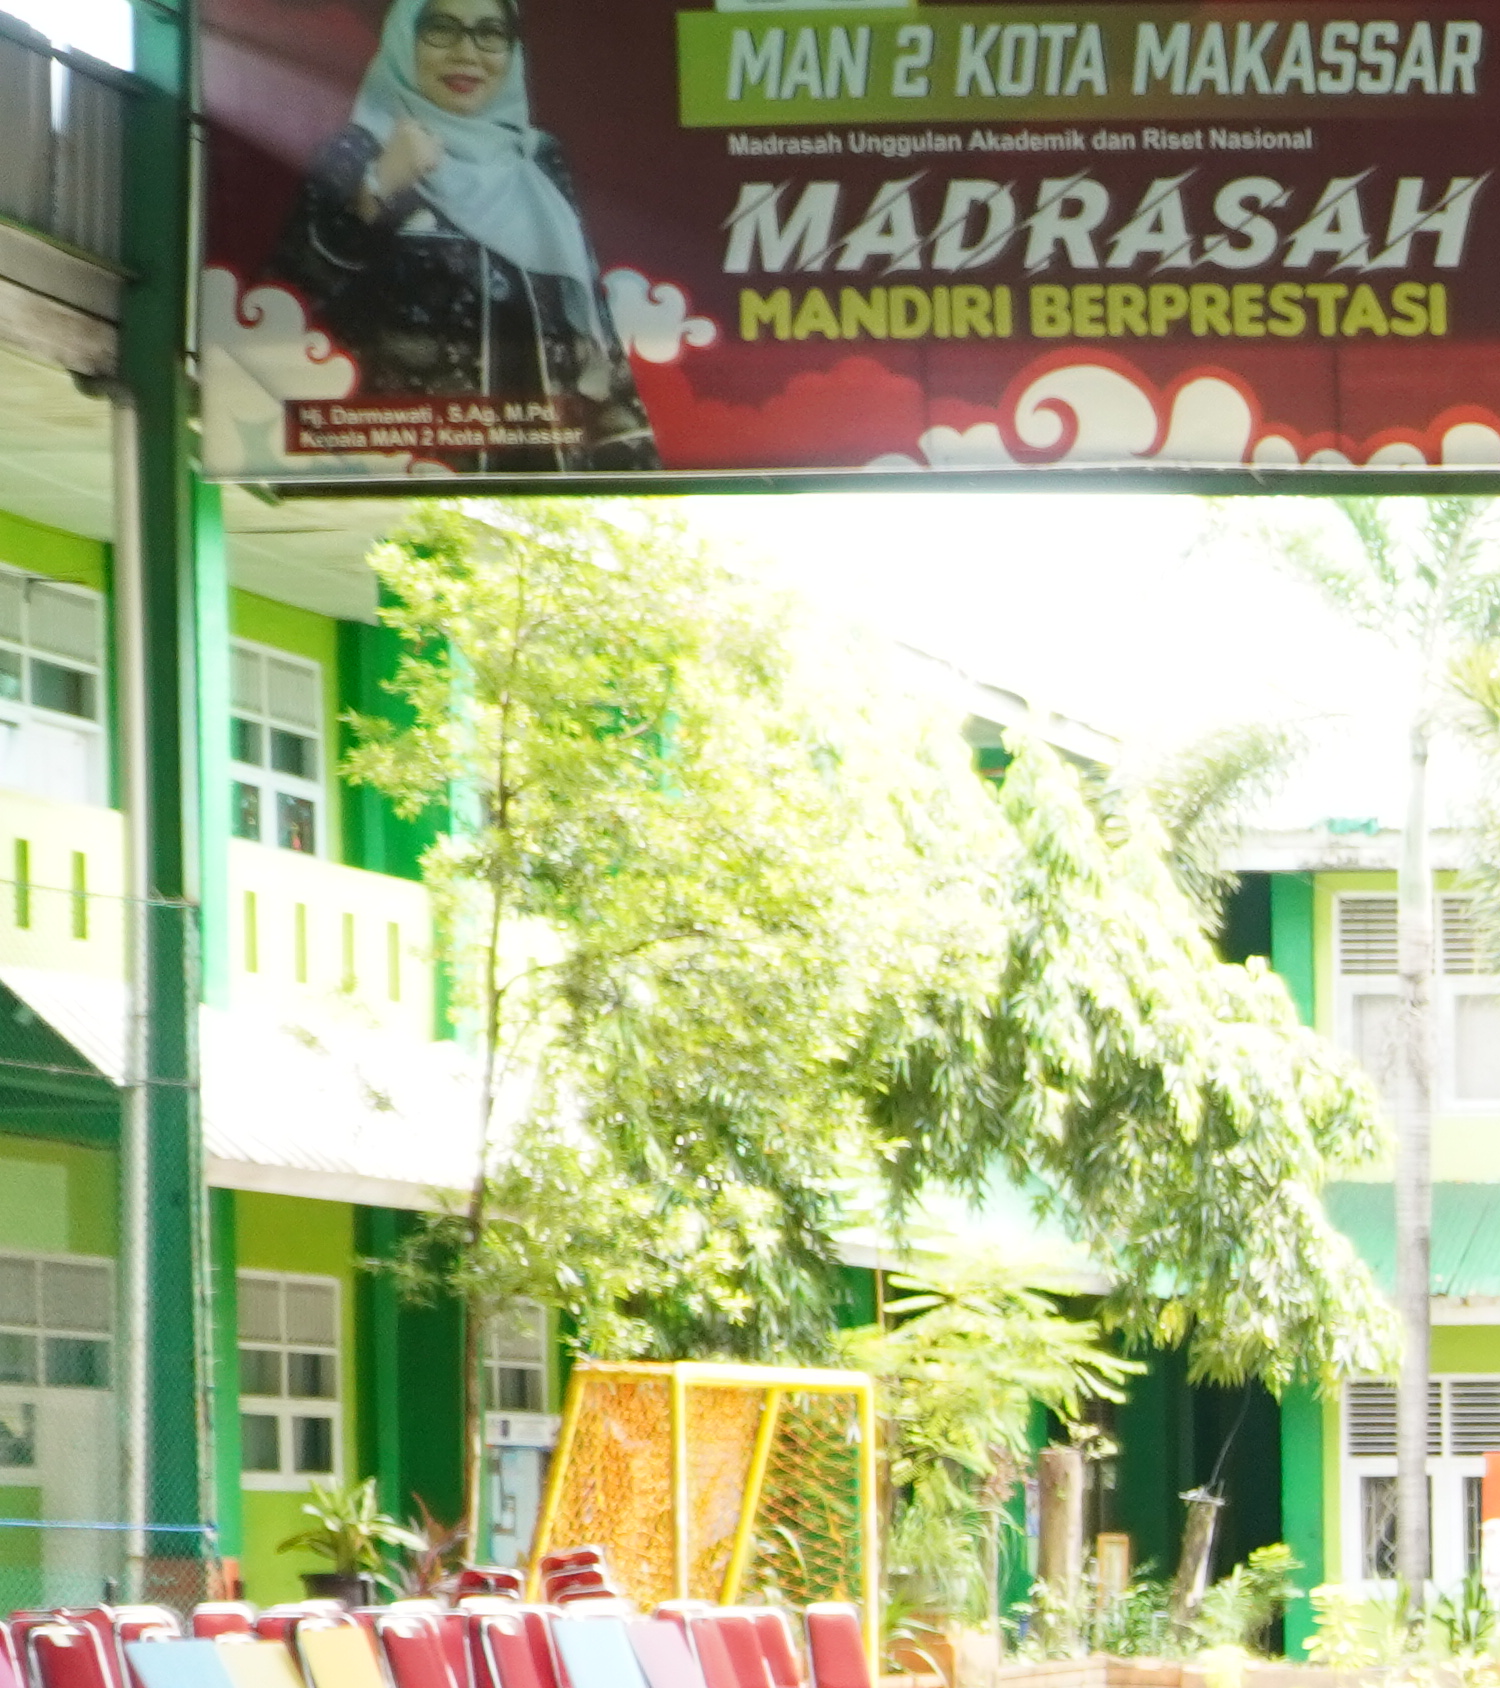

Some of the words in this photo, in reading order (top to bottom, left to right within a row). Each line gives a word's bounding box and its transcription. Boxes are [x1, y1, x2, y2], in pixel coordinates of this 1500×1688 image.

[728, 26, 871, 100] MAN
[891, 24, 934, 98] 2
[955, 23, 1107, 98] KOTA
[1132, 20, 1483, 96] MAKASSAR
[728, 133, 842, 157] Madrasah
[848, 131, 962, 158] Unggulan
[969, 129, 1085, 153] Akademik
[1092, 129, 1136, 152] dan
[1142, 128, 1203, 151] Riset
[1210, 127, 1314, 150] Nasional
[722, 167, 1493, 277] MADRASAH
[740, 287, 1012, 341] MANDIRI
[1030, 283, 1448, 338] BERPRESTASI
[300, 430, 367, 448] Kepala
[370, 428, 418, 446] MAN
[420, 428, 433, 446] 2
[436, 427, 484, 445] Kota
[487, 426, 584, 445] Makassar
